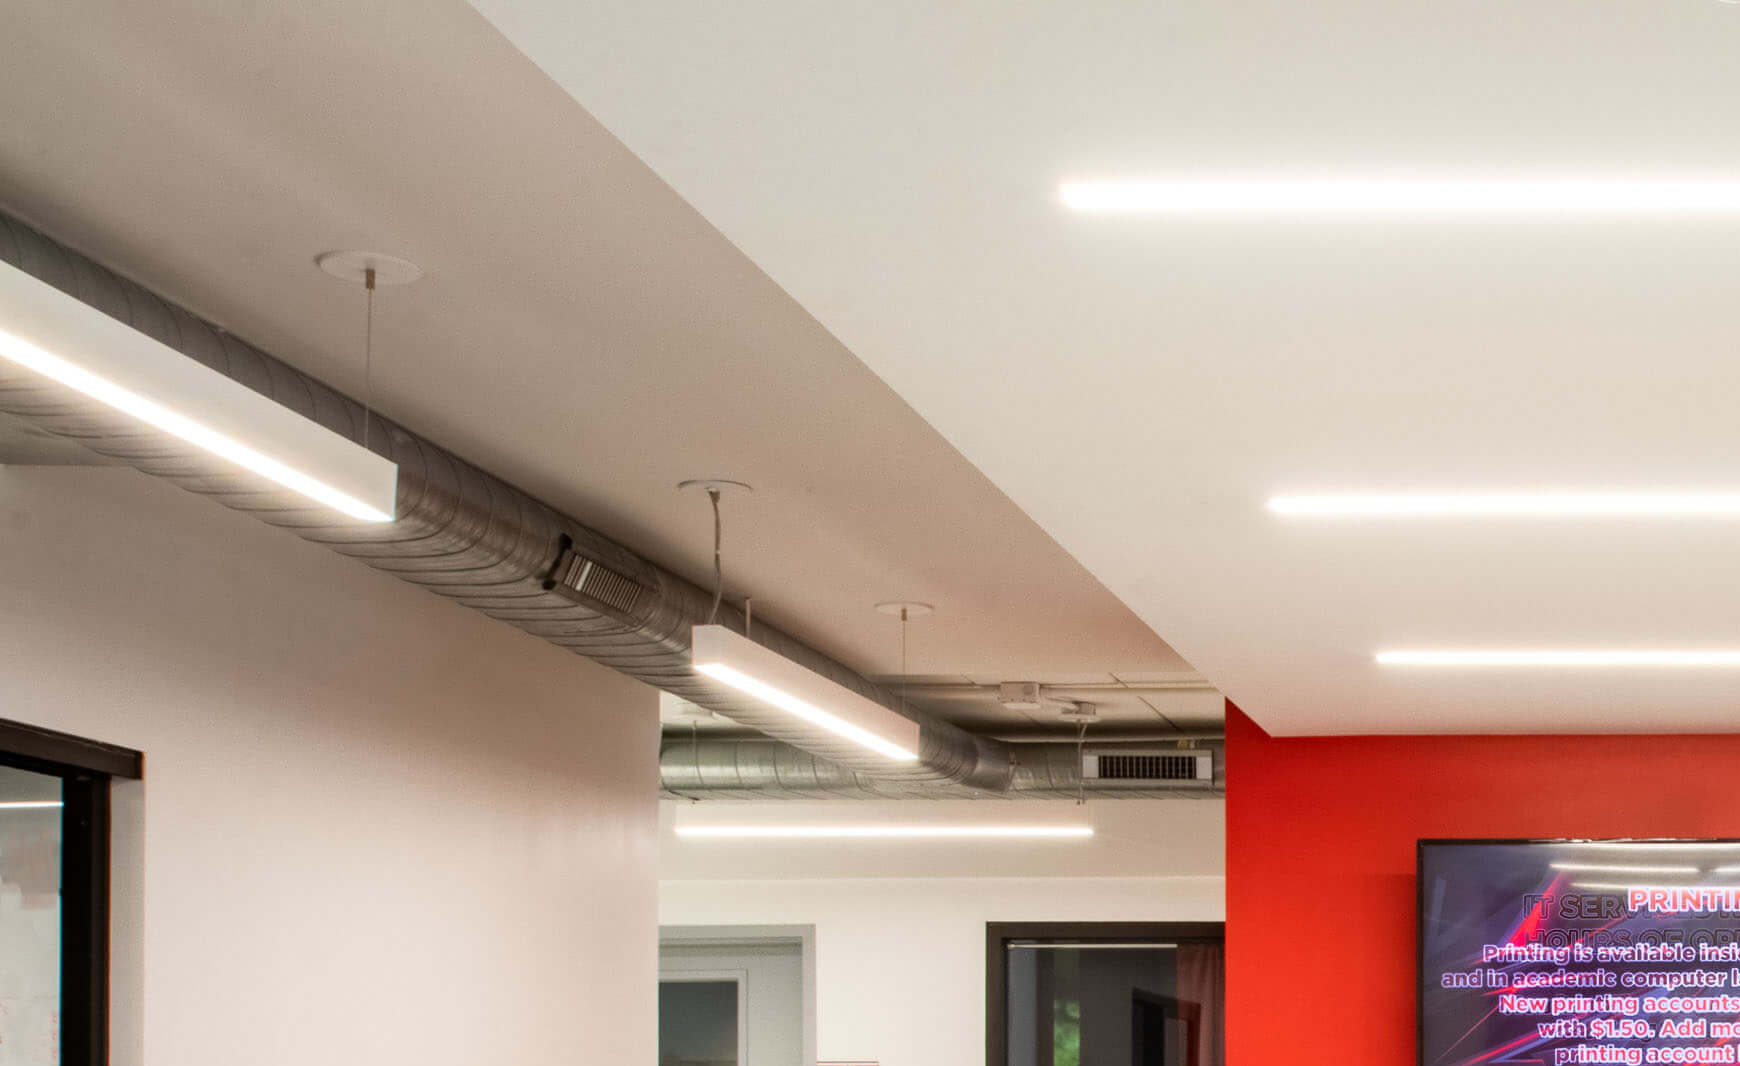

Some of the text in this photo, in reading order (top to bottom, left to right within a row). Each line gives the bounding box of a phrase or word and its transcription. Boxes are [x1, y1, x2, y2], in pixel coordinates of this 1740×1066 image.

[1483, 944, 1569, 965] Printing
[1575, 944, 1593, 962] is
[1597, 943, 1695, 962] available
[1441, 968, 1483, 988] and
[1487, 968, 1508, 987] in
[1513, 968, 1617, 987] academic
[1621, 970, 1726, 989] computer
[1499, 995, 1548, 1013] New
[1552, 994, 1638, 1015] printing
[1642, 994, 1740, 1013] accounts
[1538, 1020, 1586, 1038] with
[1591, 1019, 1655, 1039] $1.50.
[1660, 1019, 1706, 1038] Add
[1554, 1044, 1641, 1066] printing
[1646, 1045, 1735, 1063] account
